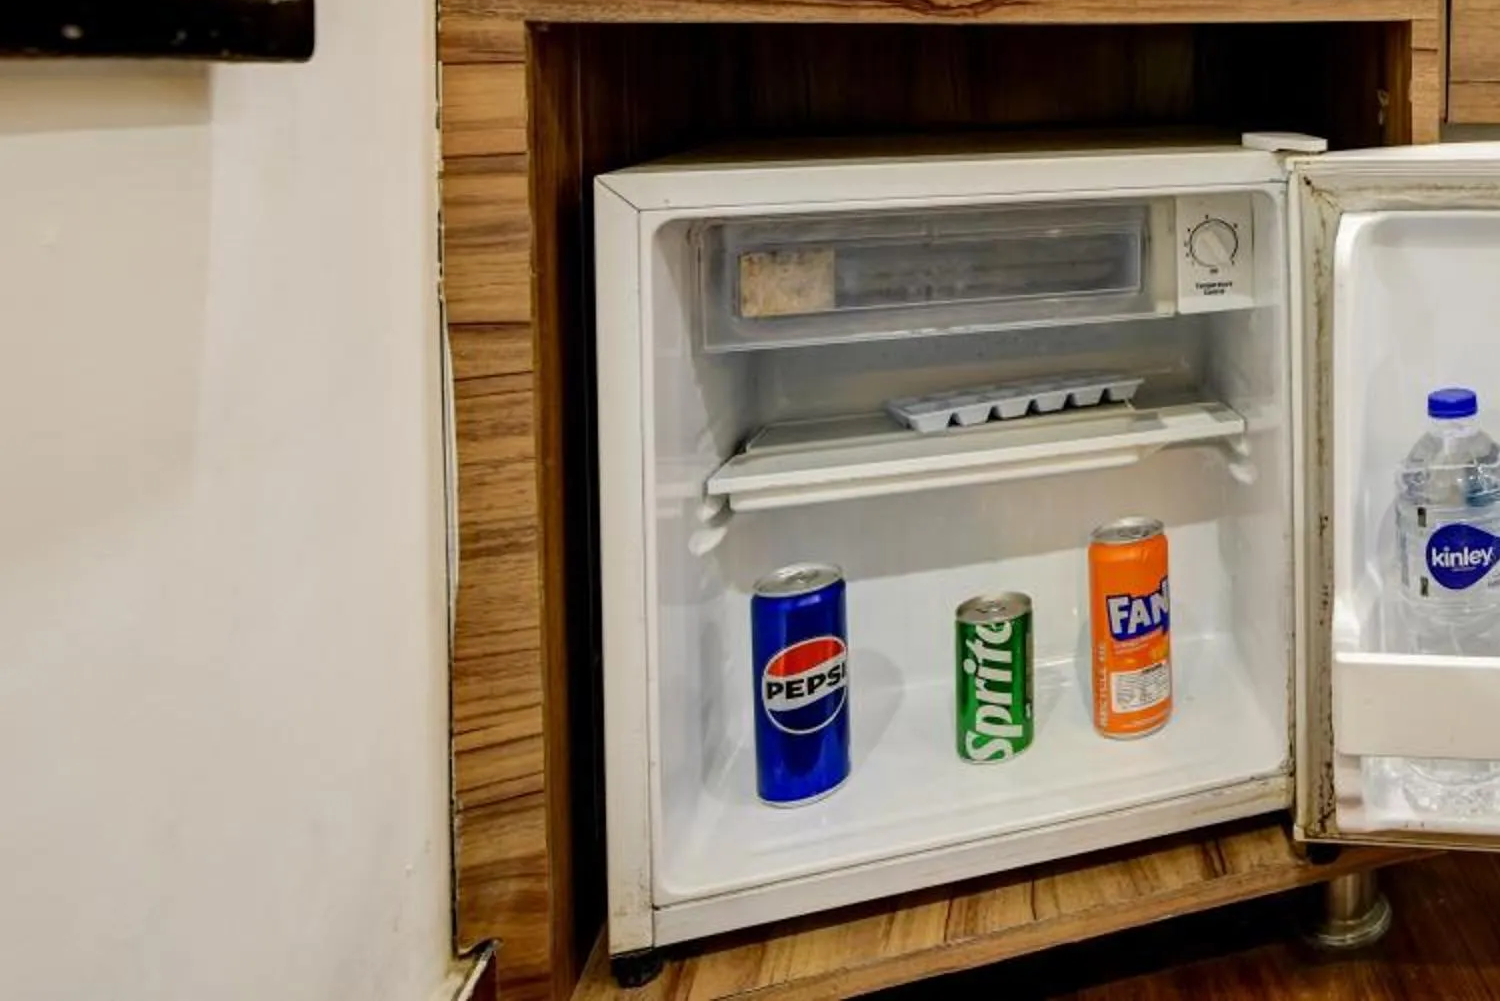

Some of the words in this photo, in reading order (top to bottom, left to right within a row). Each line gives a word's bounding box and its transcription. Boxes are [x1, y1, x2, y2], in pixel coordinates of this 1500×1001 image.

[1431, 546, 1494, 568] kinley
[766, 662, 846, 700] PEPSI
[964, 620, 1023, 762] Sprite
